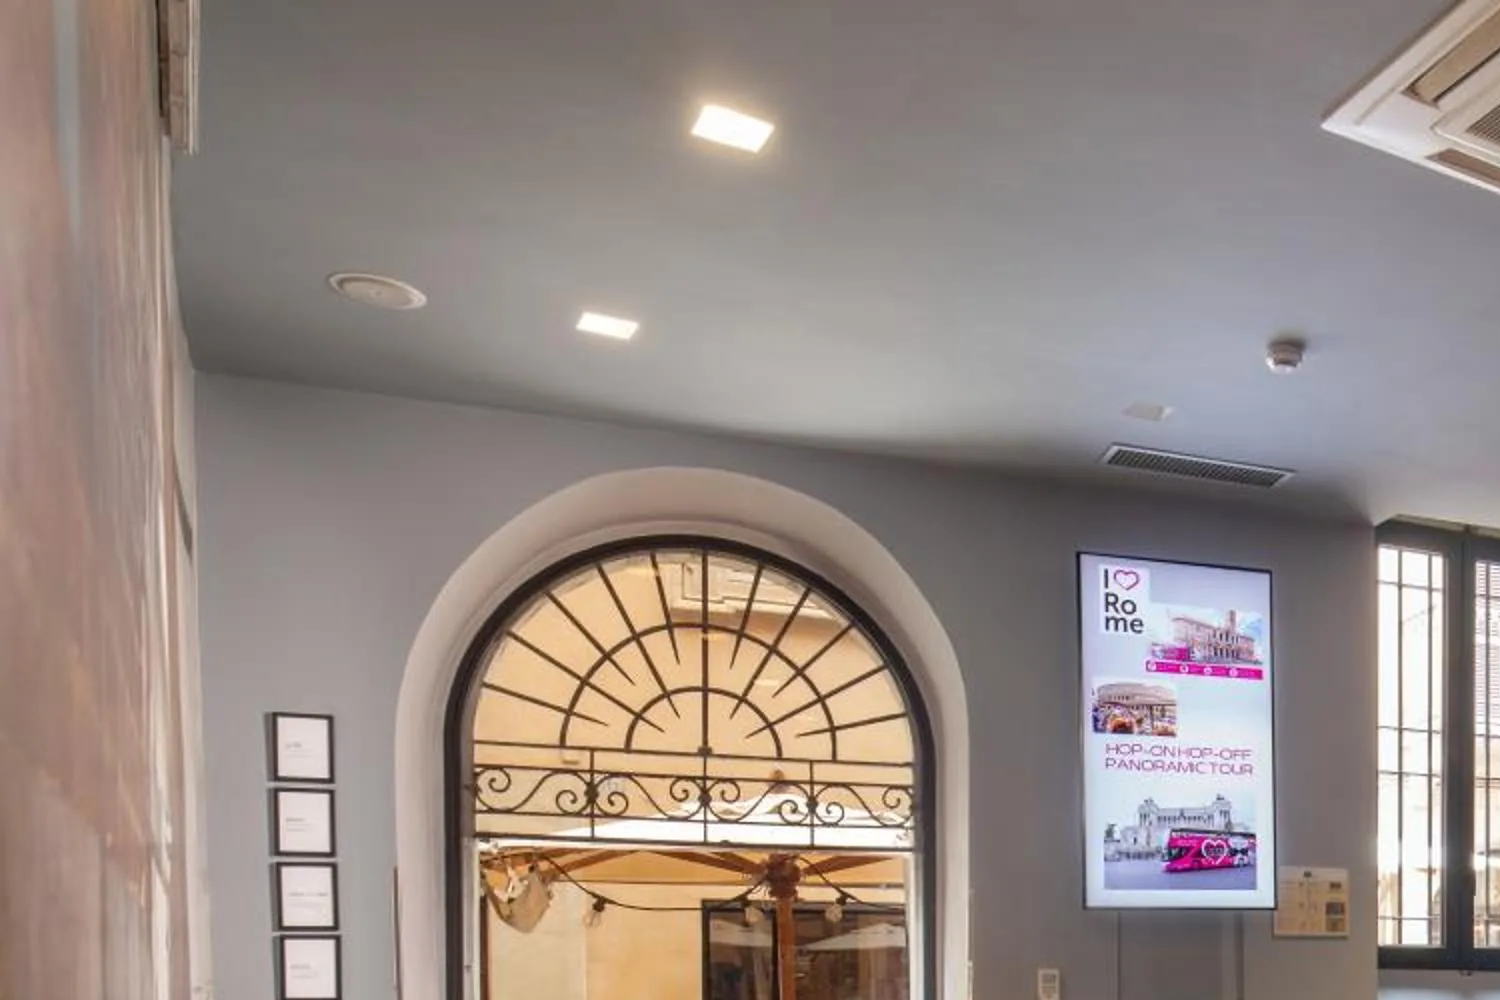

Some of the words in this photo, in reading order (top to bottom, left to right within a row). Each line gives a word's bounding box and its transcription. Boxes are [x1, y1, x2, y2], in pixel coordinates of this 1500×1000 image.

[1103, 568, 1109, 589] I
[1104, 592, 1137, 615] Ro
[1104, 616, 1145, 634] me
[1178, 747, 1252, 760] HOP-OFF
[1105, 757, 1206, 774] PANORAMIC
[1209, 762, 1254, 775] TOUR
